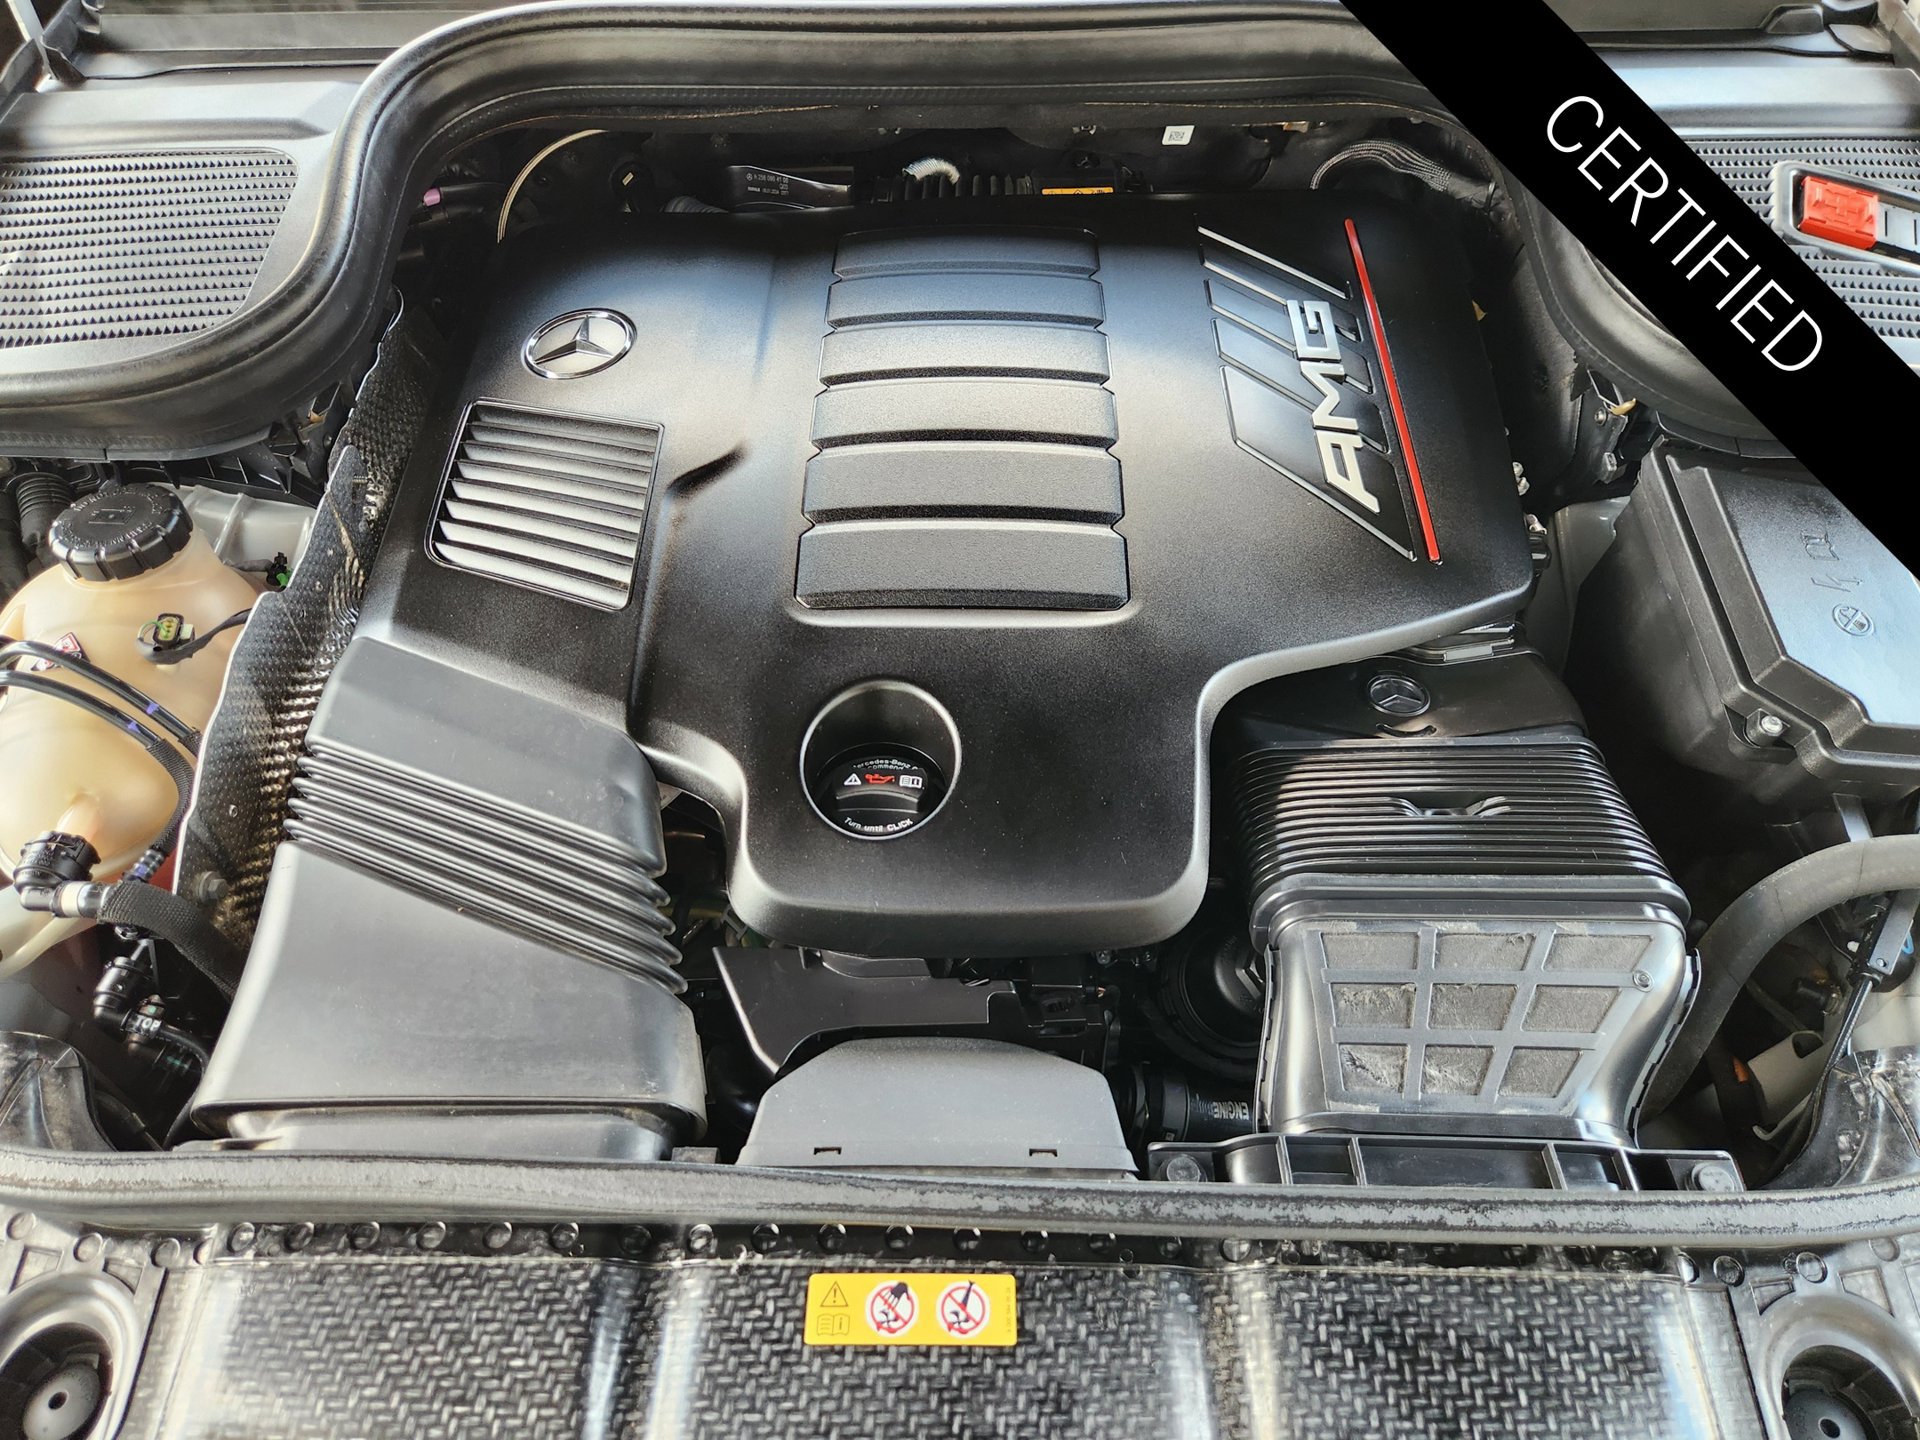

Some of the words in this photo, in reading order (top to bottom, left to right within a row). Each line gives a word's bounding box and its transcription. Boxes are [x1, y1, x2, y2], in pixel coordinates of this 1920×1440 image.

[1286, 300, 1380, 514] AMG
[844, 816, 862, 830] Turn
[863, 824, 884, 833] until
[886, 818, 914, 832] CLICK
[133, 1013, 162, 1032] TOP
[1213, 1101, 1250, 1121] ENGINE
